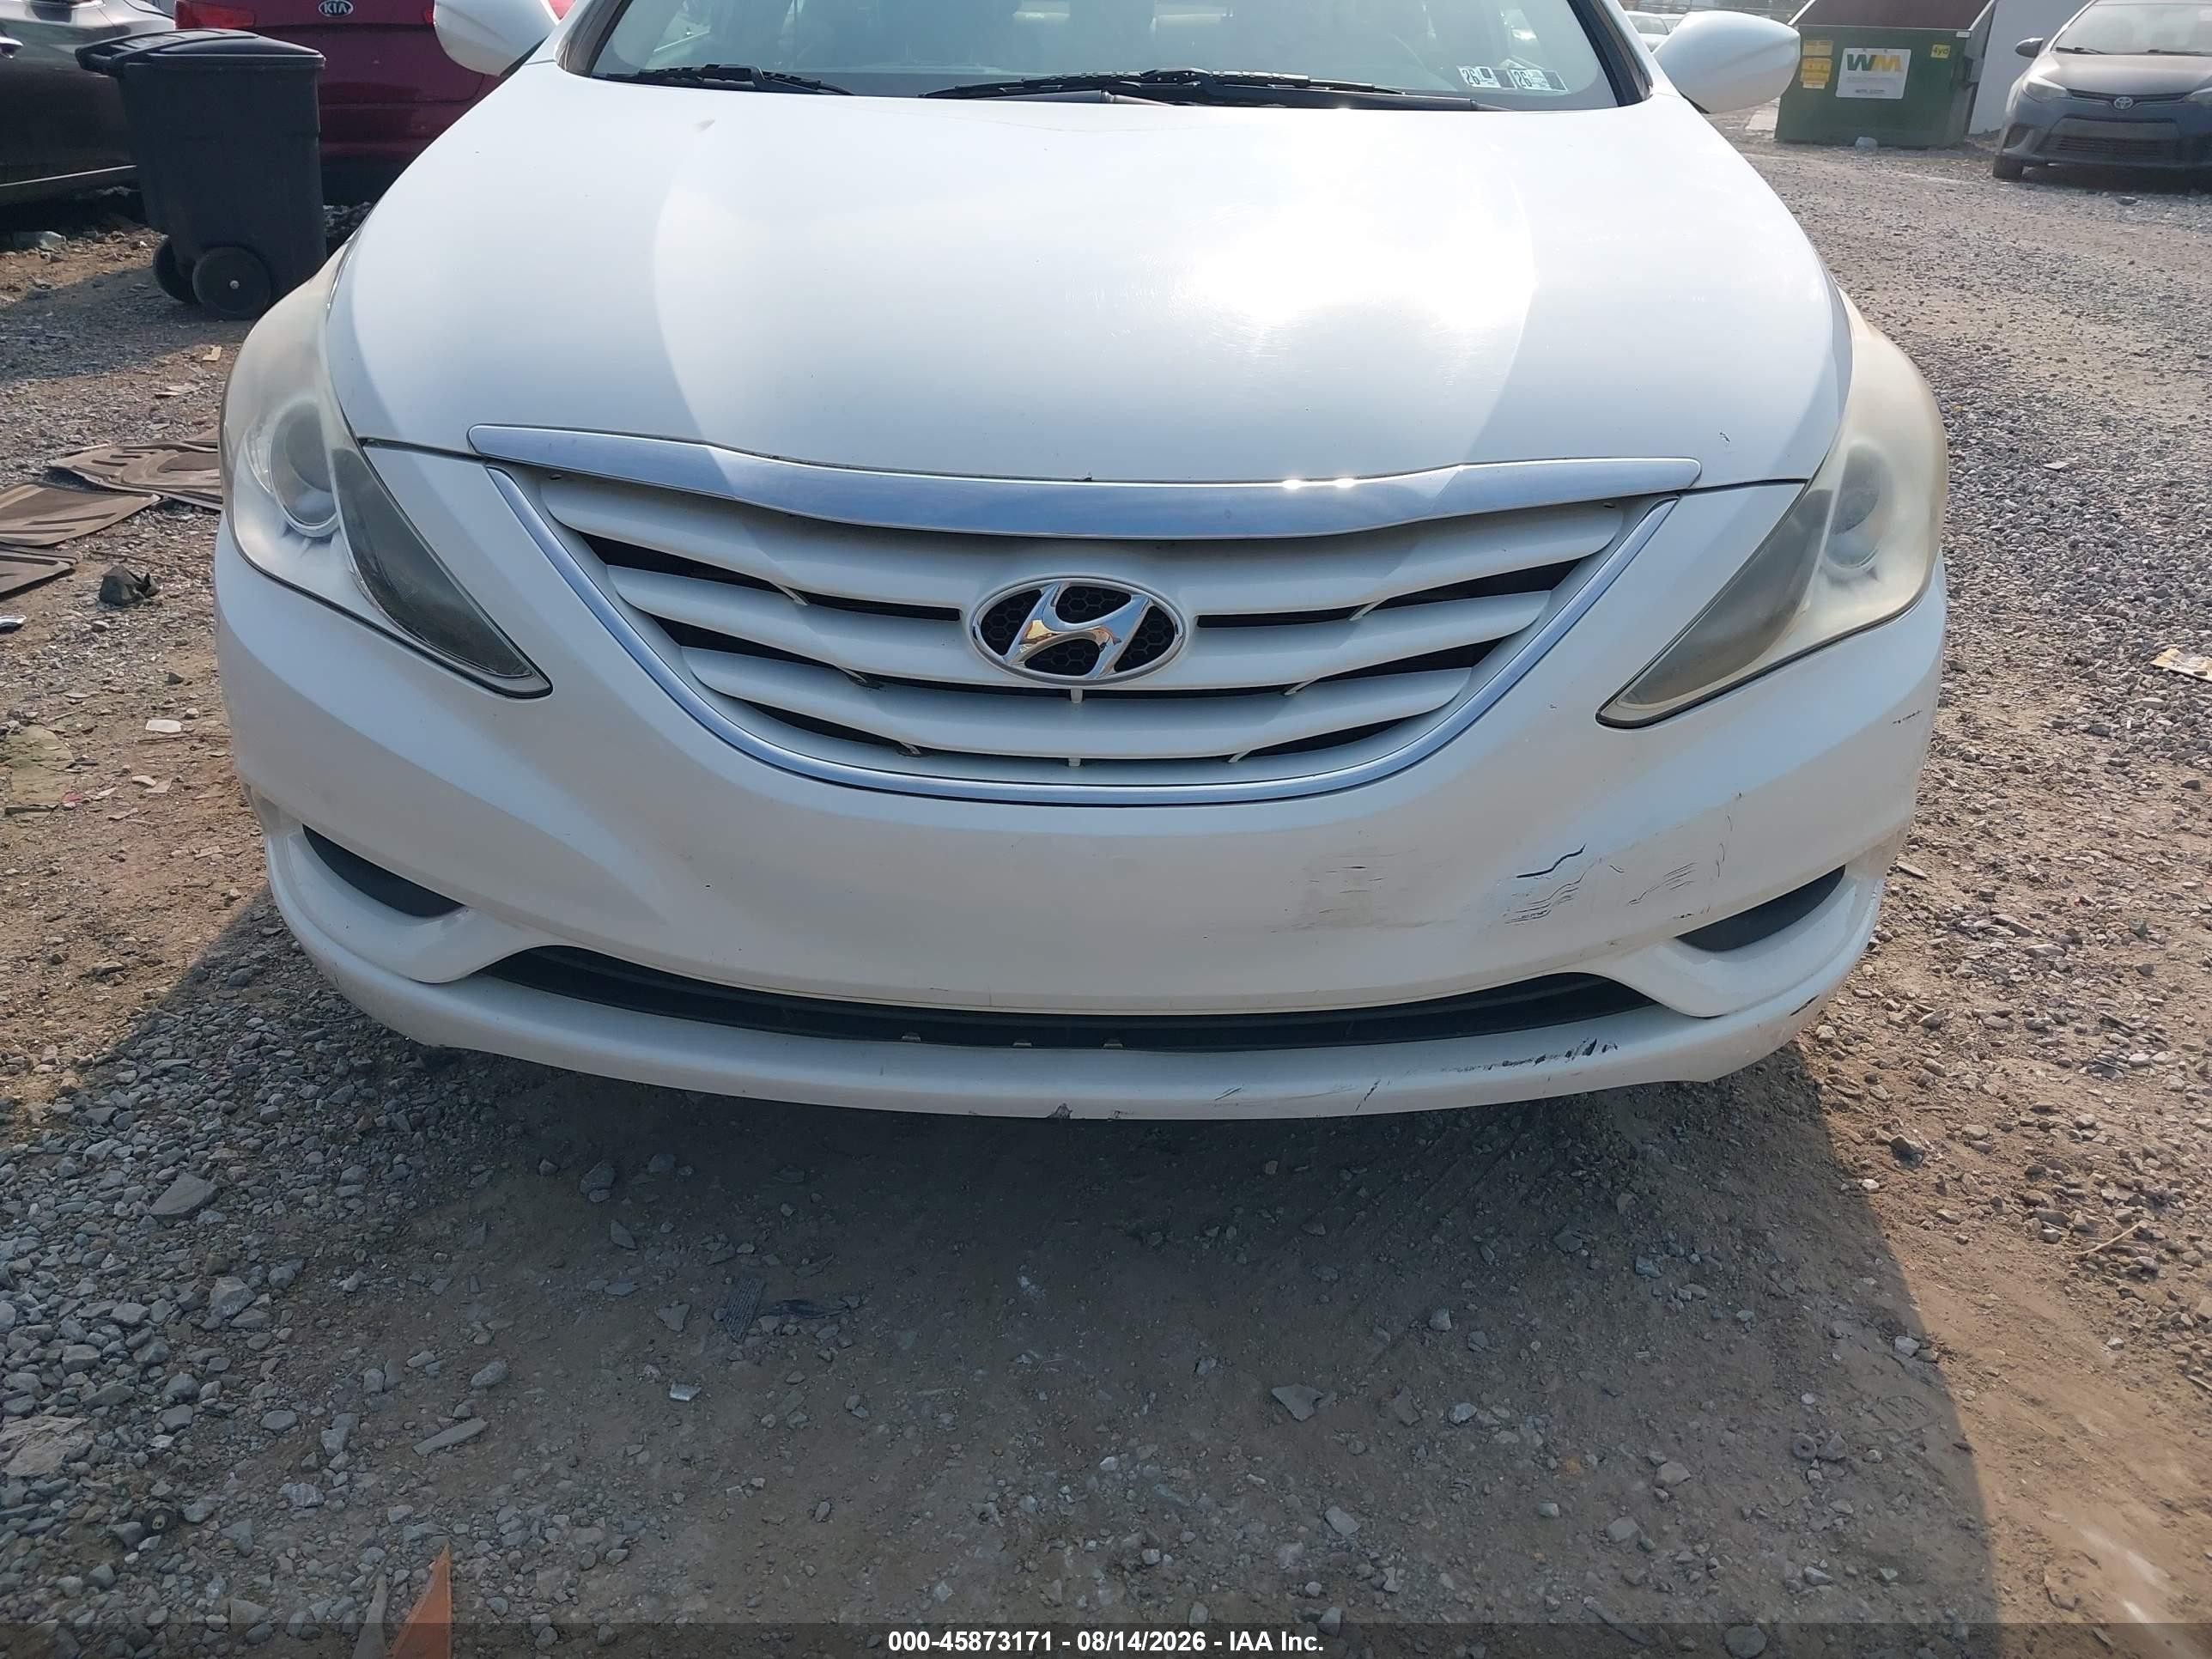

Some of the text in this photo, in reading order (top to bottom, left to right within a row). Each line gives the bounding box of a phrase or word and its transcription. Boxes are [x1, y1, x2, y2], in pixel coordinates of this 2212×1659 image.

[324, 3, 348, 13] KIA
[1847, 54, 1903, 71] WM
[1462, 70, 1480, 85] 26
[1514, 71, 1533, 87] 26
